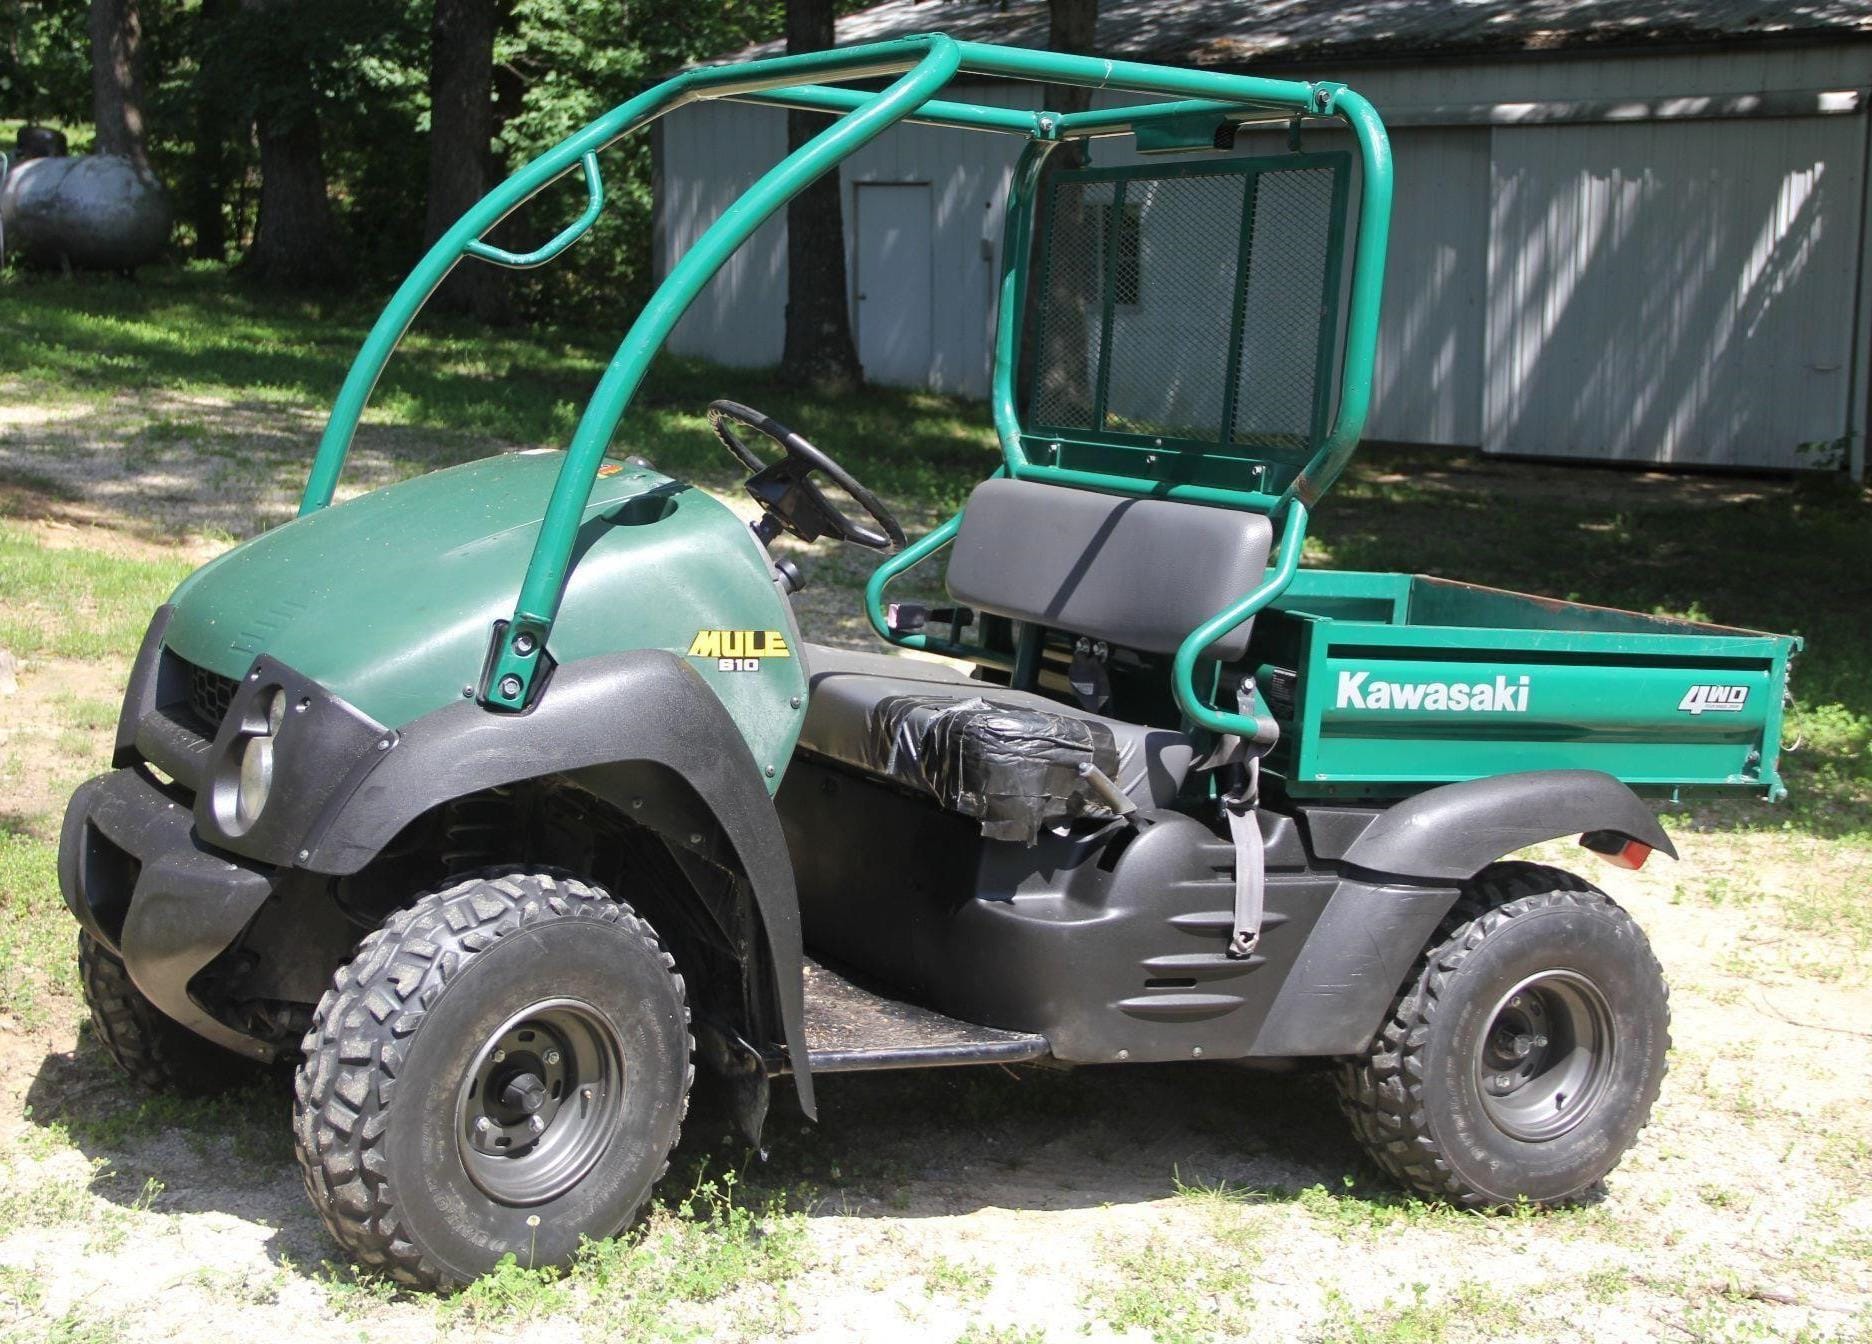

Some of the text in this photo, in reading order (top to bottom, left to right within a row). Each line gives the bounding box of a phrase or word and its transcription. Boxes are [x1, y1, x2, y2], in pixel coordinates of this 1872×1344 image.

[687, 630, 790, 656] MULE
[1336, 671, 1530, 711] Kawasaki
[1678, 685, 1749, 714] 4WD
